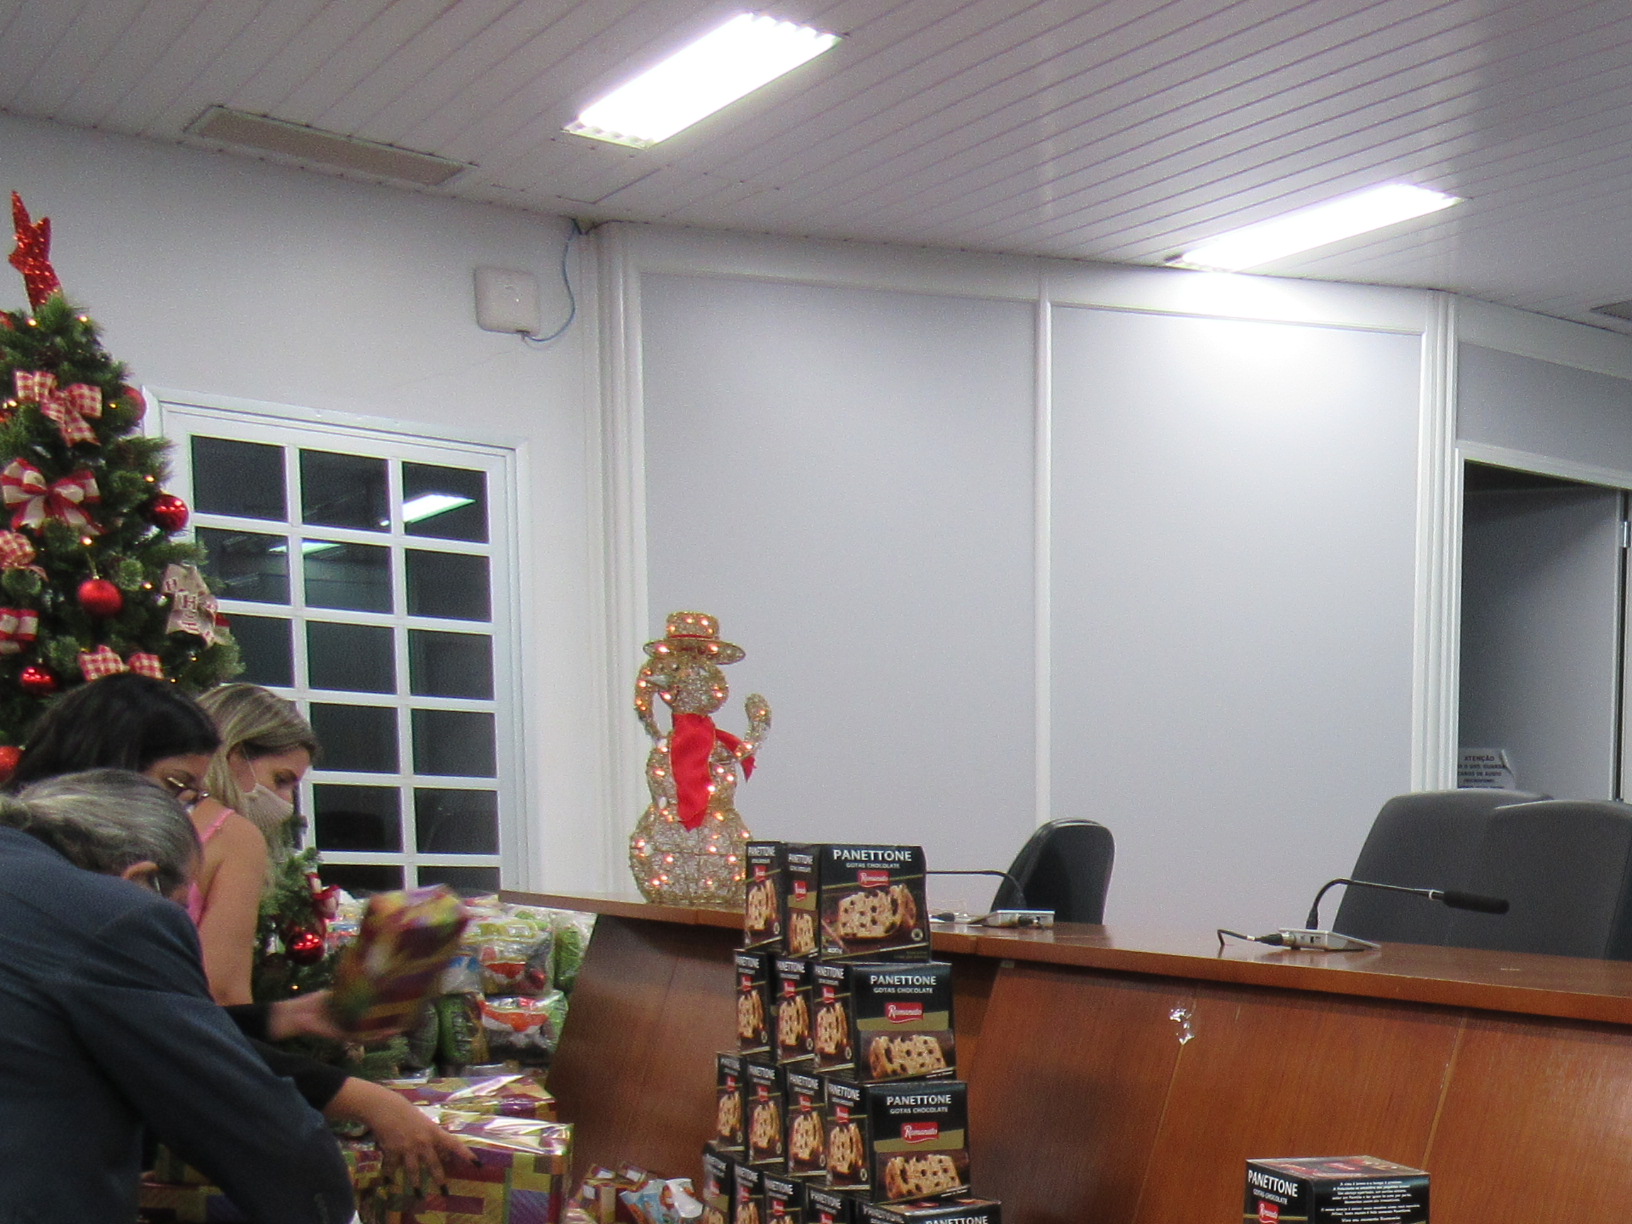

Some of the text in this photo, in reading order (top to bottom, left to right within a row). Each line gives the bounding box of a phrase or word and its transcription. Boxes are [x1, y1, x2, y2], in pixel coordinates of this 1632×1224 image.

[833, 850, 912, 862] PANETTONE
[870, 975, 936, 985] PANETTONE
[887, 1095, 952, 1105] PANETTONE
[1248, 1169, 1298, 1198] PANETTONE
